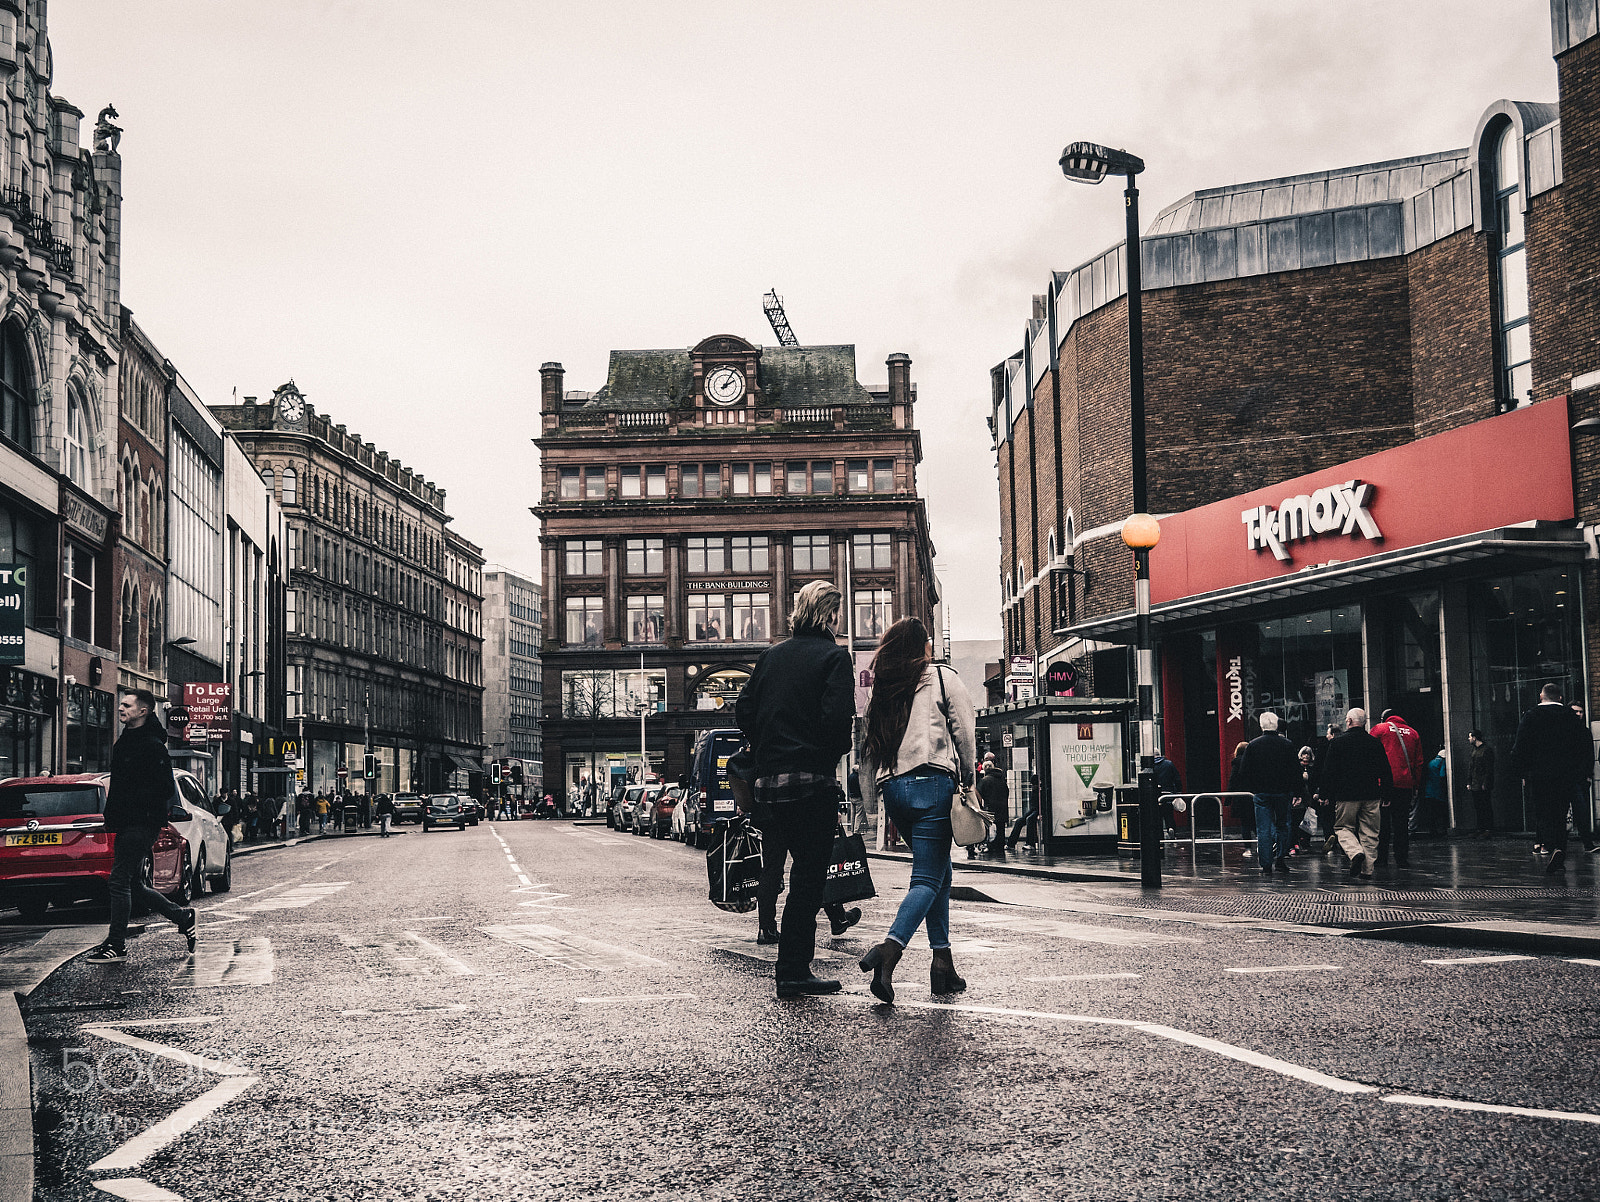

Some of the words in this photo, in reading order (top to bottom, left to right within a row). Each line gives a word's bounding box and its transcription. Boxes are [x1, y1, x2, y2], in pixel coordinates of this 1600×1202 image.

[1126, 196, 1131, 207] 3
[1135, 560, 1140, 571] 3
[1049, 671, 1074, 682] HMV
[186, 683, 205, 695] To
[208, 684, 230, 696] Let
[196, 697, 220, 705] Large
[187, 705, 211, 713] Retail
[212, 705, 229, 713] Unit
[1062, 744, 1088, 753] WHO'D
[1089, 744, 1110, 753] HAVE
[1065, 753, 1107, 762] THOUGHT?
[10, 835, 30, 844] YFZ
